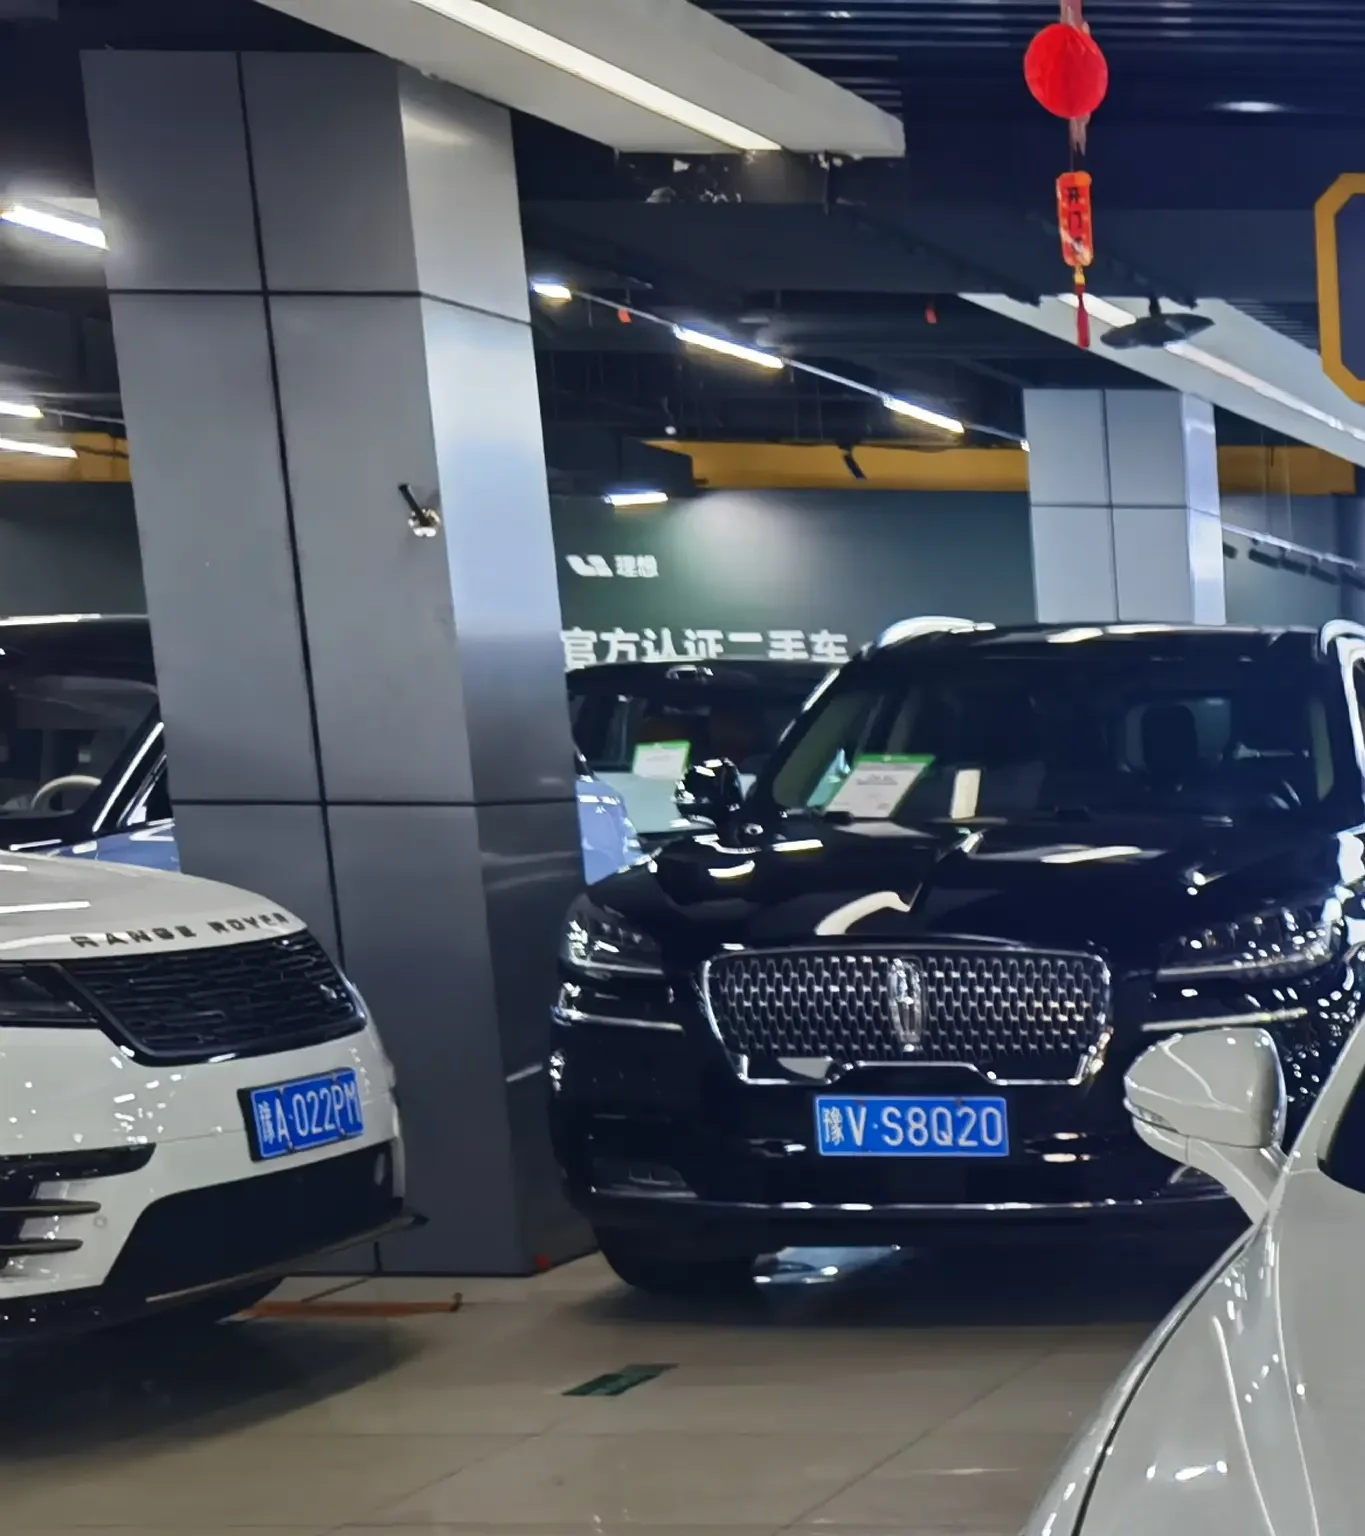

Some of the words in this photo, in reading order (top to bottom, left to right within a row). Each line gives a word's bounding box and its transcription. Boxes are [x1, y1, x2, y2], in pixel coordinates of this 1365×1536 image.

[559, 626, 849, 669] 官方认证二手车
[70, 929, 197, 949] RANGE
[206, 911, 290, 934] ROVER
